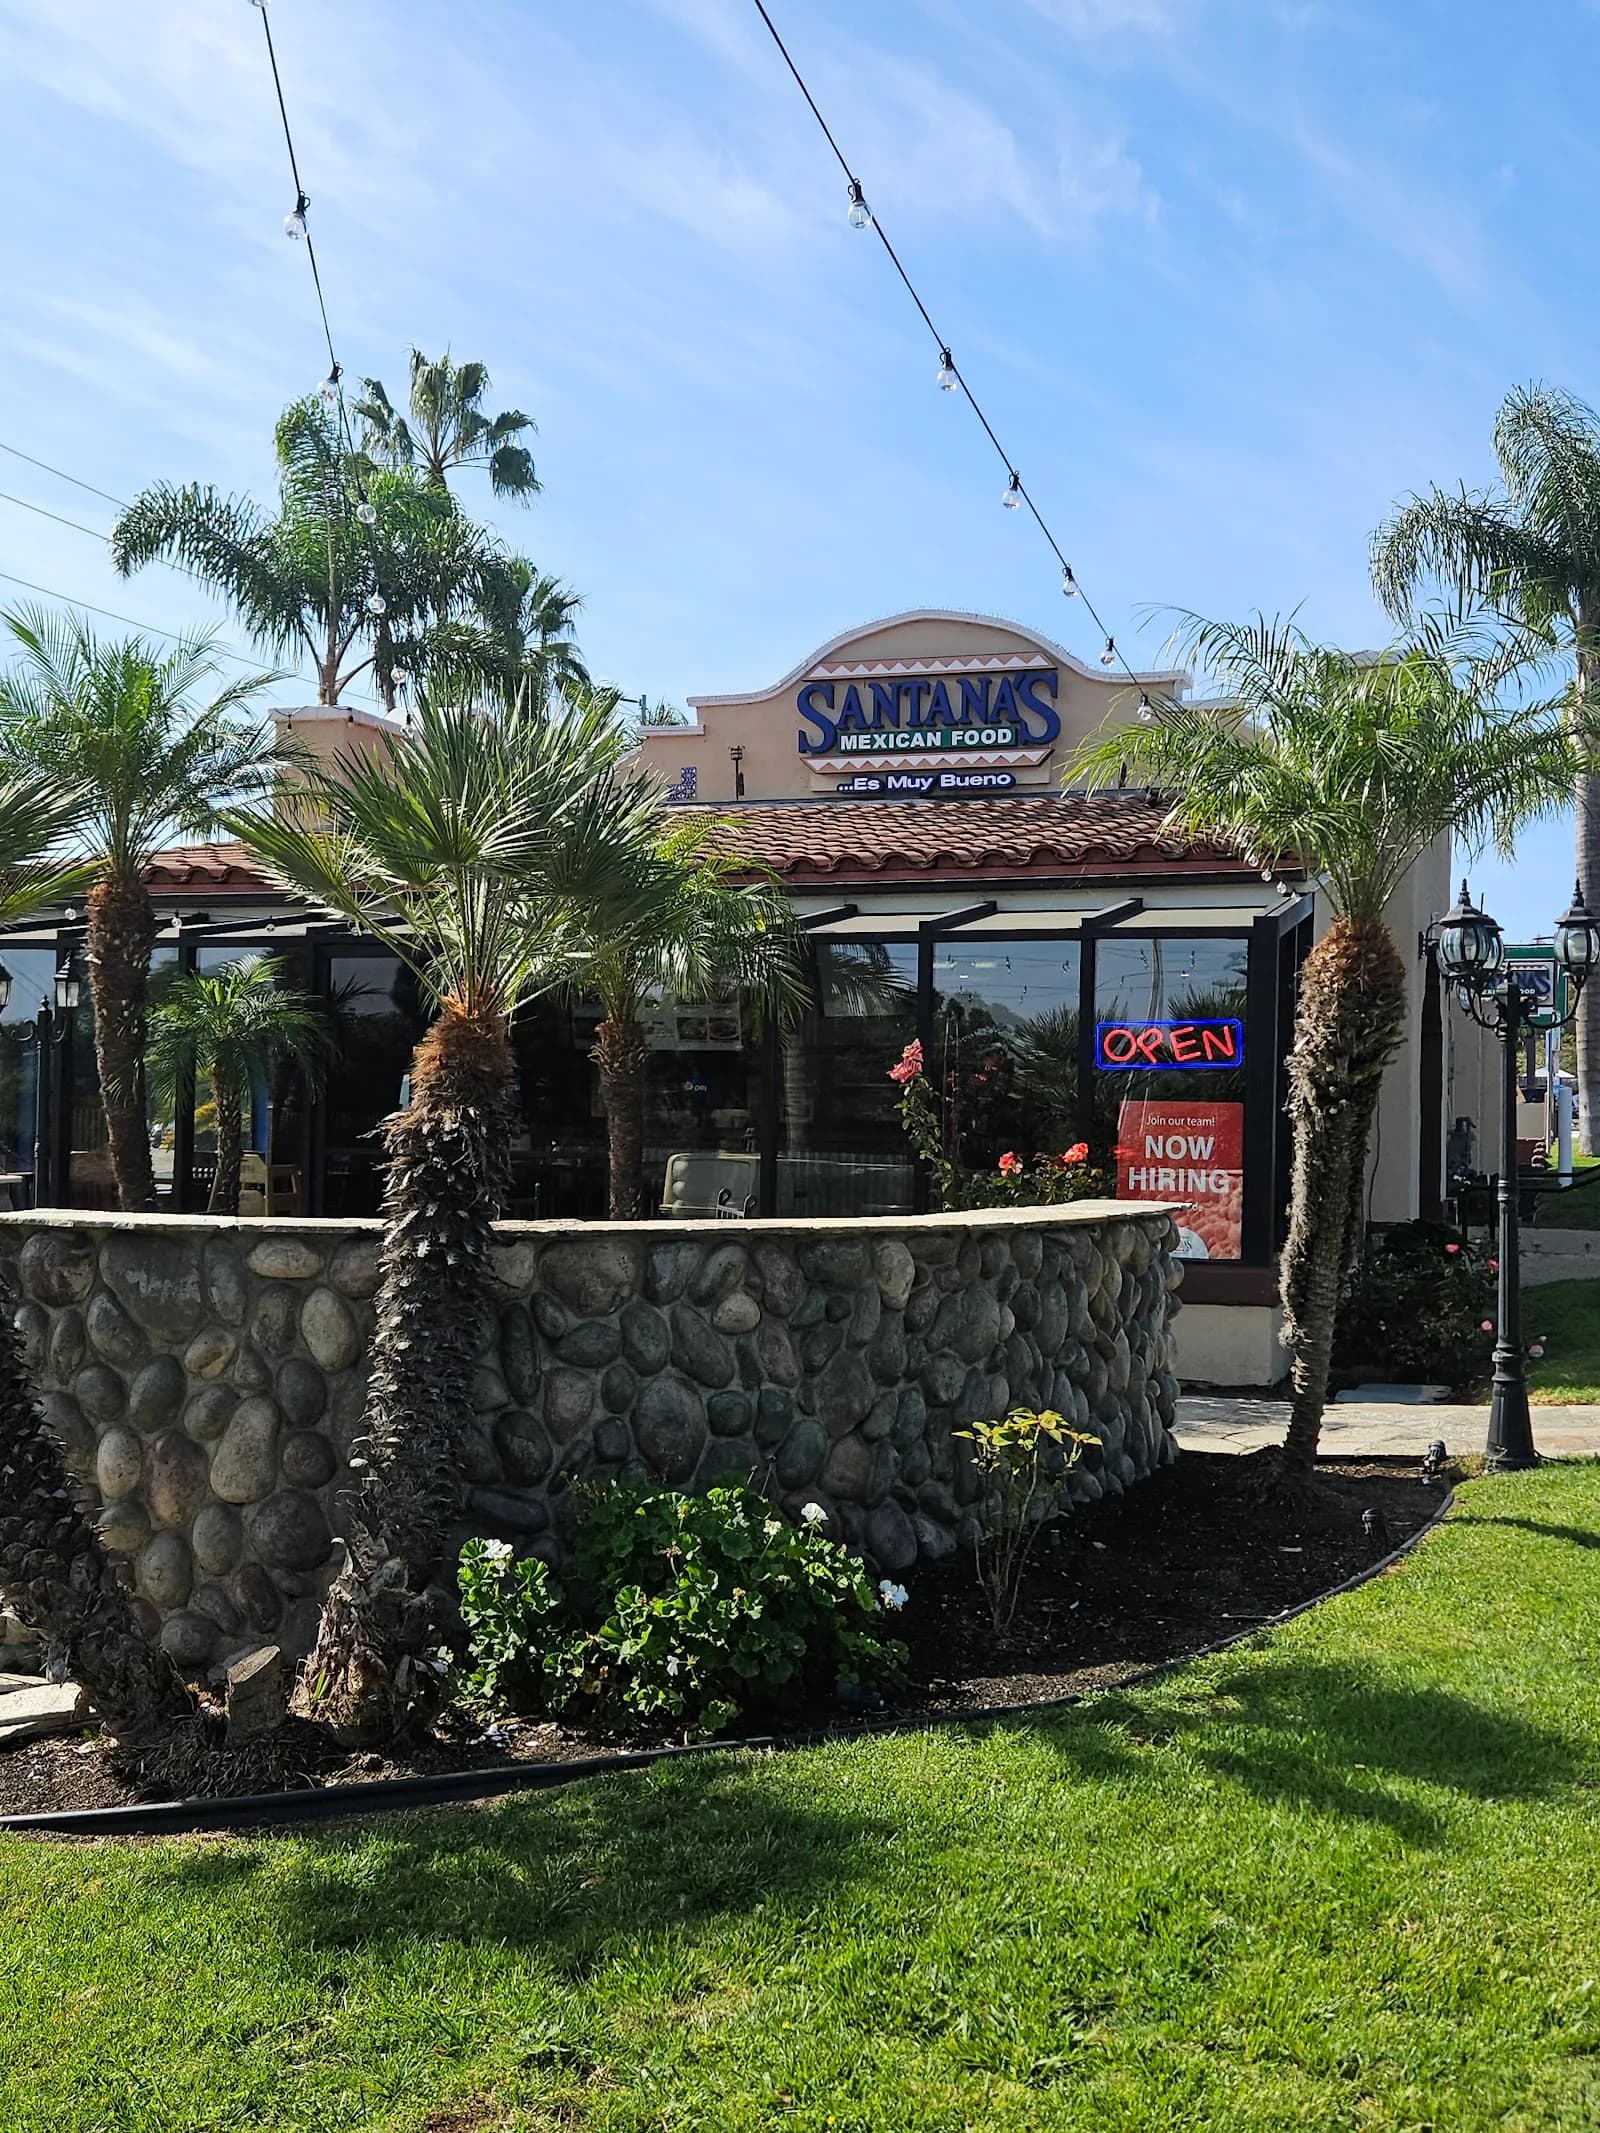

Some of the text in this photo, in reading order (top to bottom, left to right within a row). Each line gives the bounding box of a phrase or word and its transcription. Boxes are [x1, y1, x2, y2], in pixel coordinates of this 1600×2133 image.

[797, 671, 1061, 754] SANTANA'S
[840, 728, 1013, 750] MEXICAN FOOD
[887, 775, 934, 791] Muy
[940, 773, 1012, 788] Bueno
[1103, 1025, 1235, 1064] OPEN
[1146, 1115, 1215, 1127] Join our team!
[1145, 1135, 1214, 1160] NOW
[1128, 1166, 1230, 1194] HIRING
